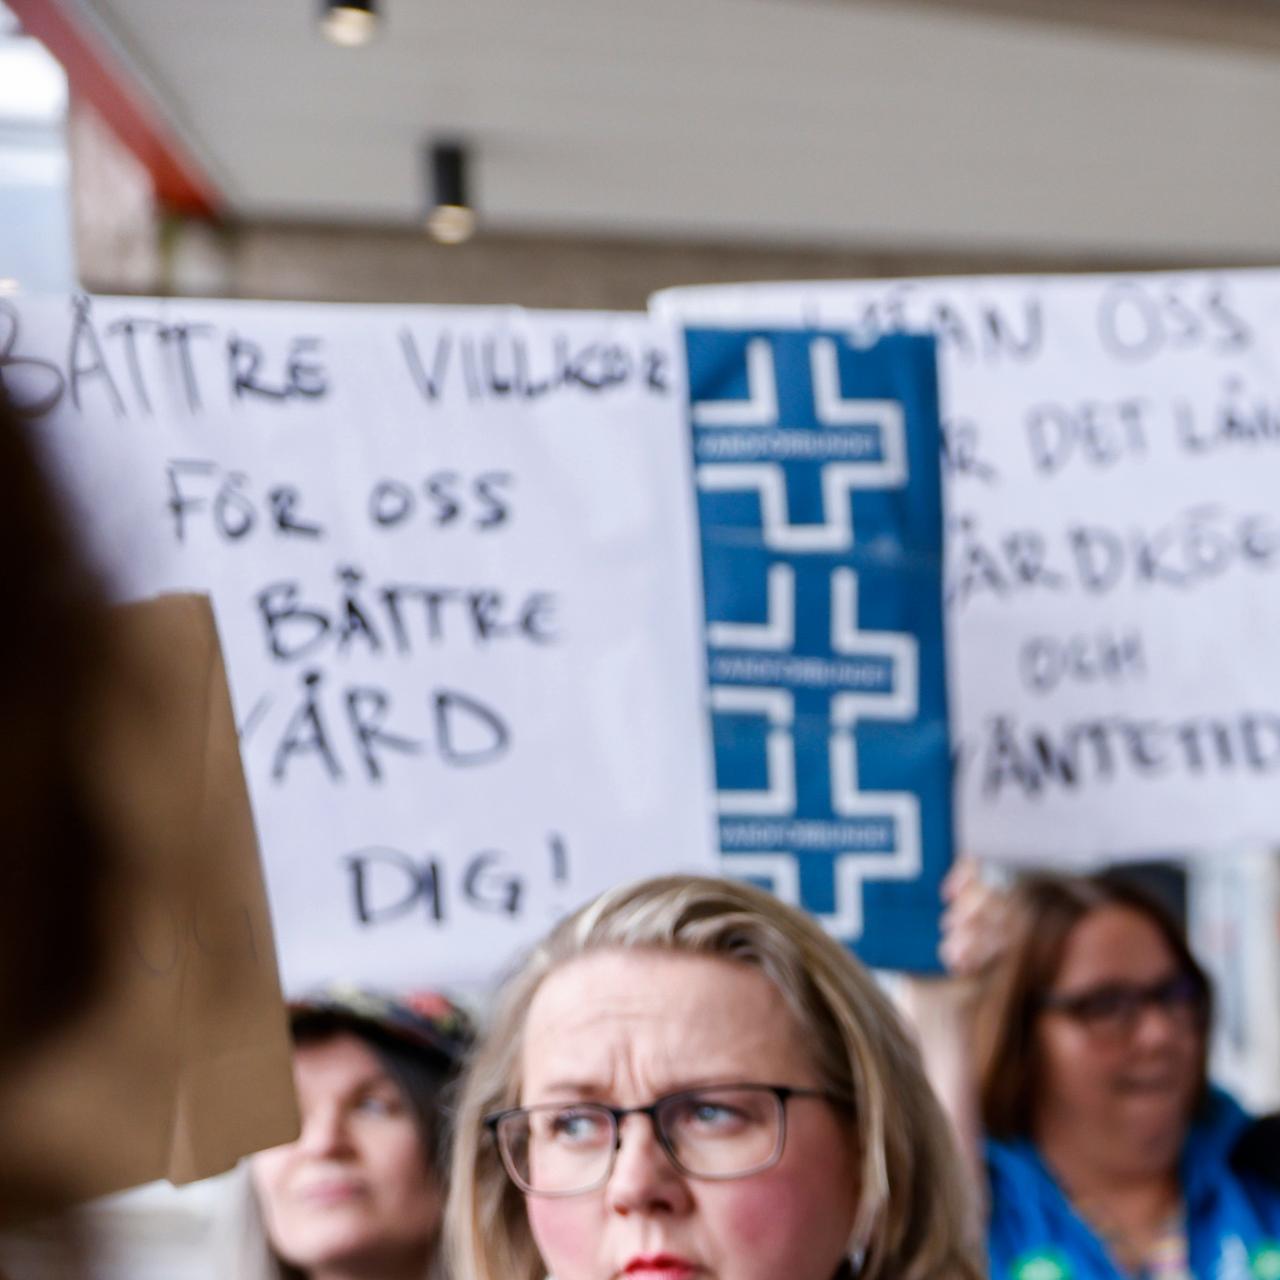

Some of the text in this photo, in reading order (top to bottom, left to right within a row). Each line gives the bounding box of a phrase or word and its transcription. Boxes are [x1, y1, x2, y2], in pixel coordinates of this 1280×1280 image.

[398, 325, 675, 406] VILLKOR
[166, 457, 516, 543] FÖR OSS
